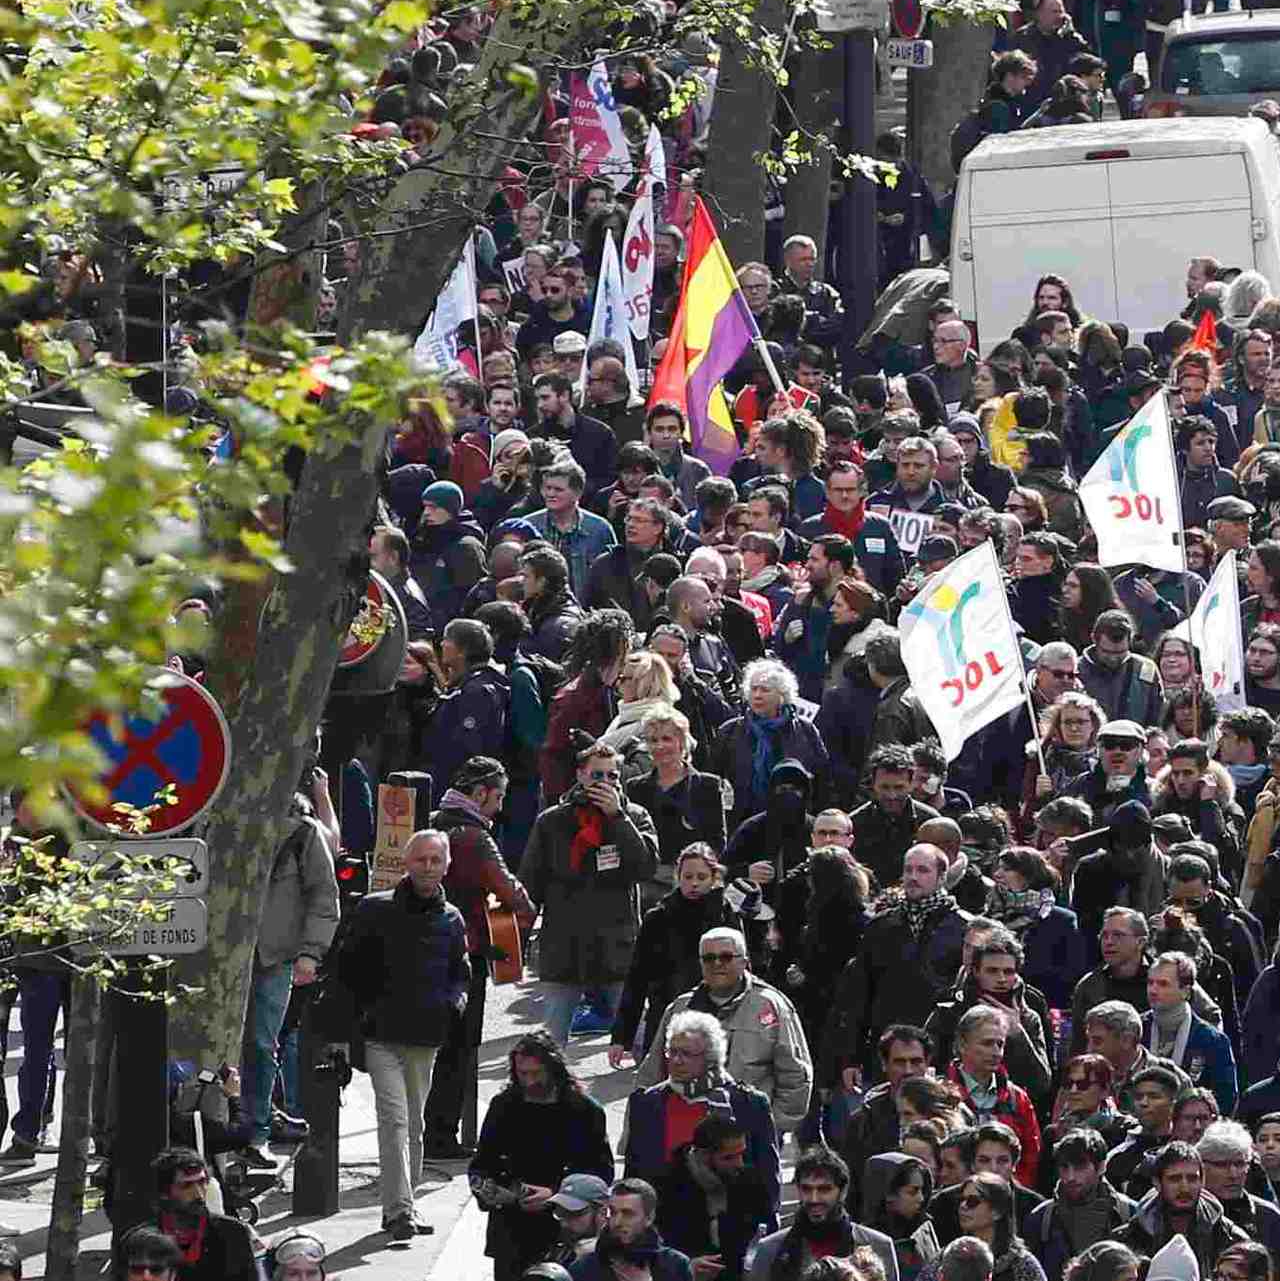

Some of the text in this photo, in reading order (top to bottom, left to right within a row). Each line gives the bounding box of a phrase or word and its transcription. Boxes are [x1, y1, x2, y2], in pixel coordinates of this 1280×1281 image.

[888, 45, 912, 60] SAUF
[143, 929, 157, 944] DE
[162, 928, 197, 944] FONDS
